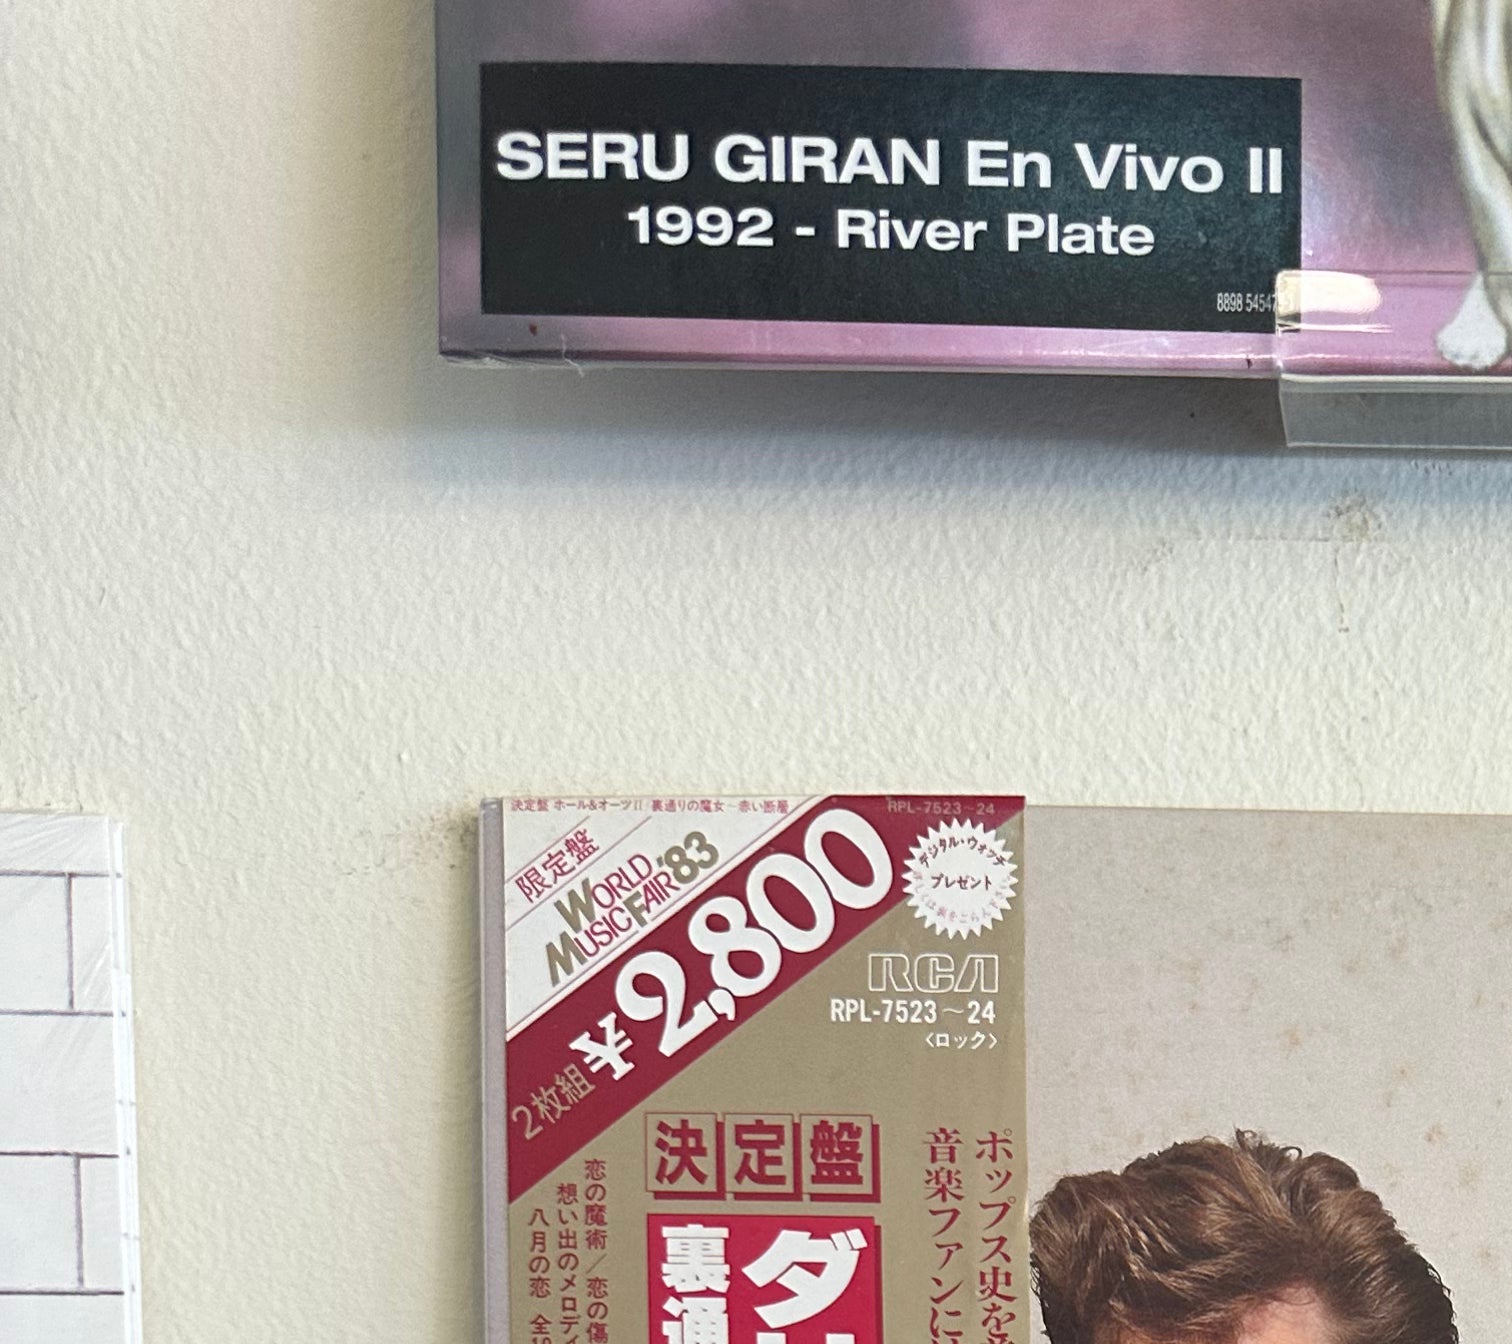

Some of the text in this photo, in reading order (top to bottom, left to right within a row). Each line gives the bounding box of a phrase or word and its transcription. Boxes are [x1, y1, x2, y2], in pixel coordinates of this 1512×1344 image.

[495, 131, 1284, 195] SERU GIRAN En Vivo II
[626, 206, 773, 247] 1992
[837, 208, 987, 251] River
[1007, 213, 1156, 257] Plate
[1216, 293, 1244, 312] 8898
[515, 828, 599, 903] 限定盤
[554, 853, 654, 934] WORLD
[931, 873, 993, 891] プレゼント
[546, 906, 632, 987] MUSIC
[623, 870, 680, 928] FAIR
[867, 952, 999, 994] RCA
[511, 1062, 598, 1140] 2枚組
[652, 1118, 866, 1188] 決定盤
[528, 1208, 552, 1298] 八月の恋
